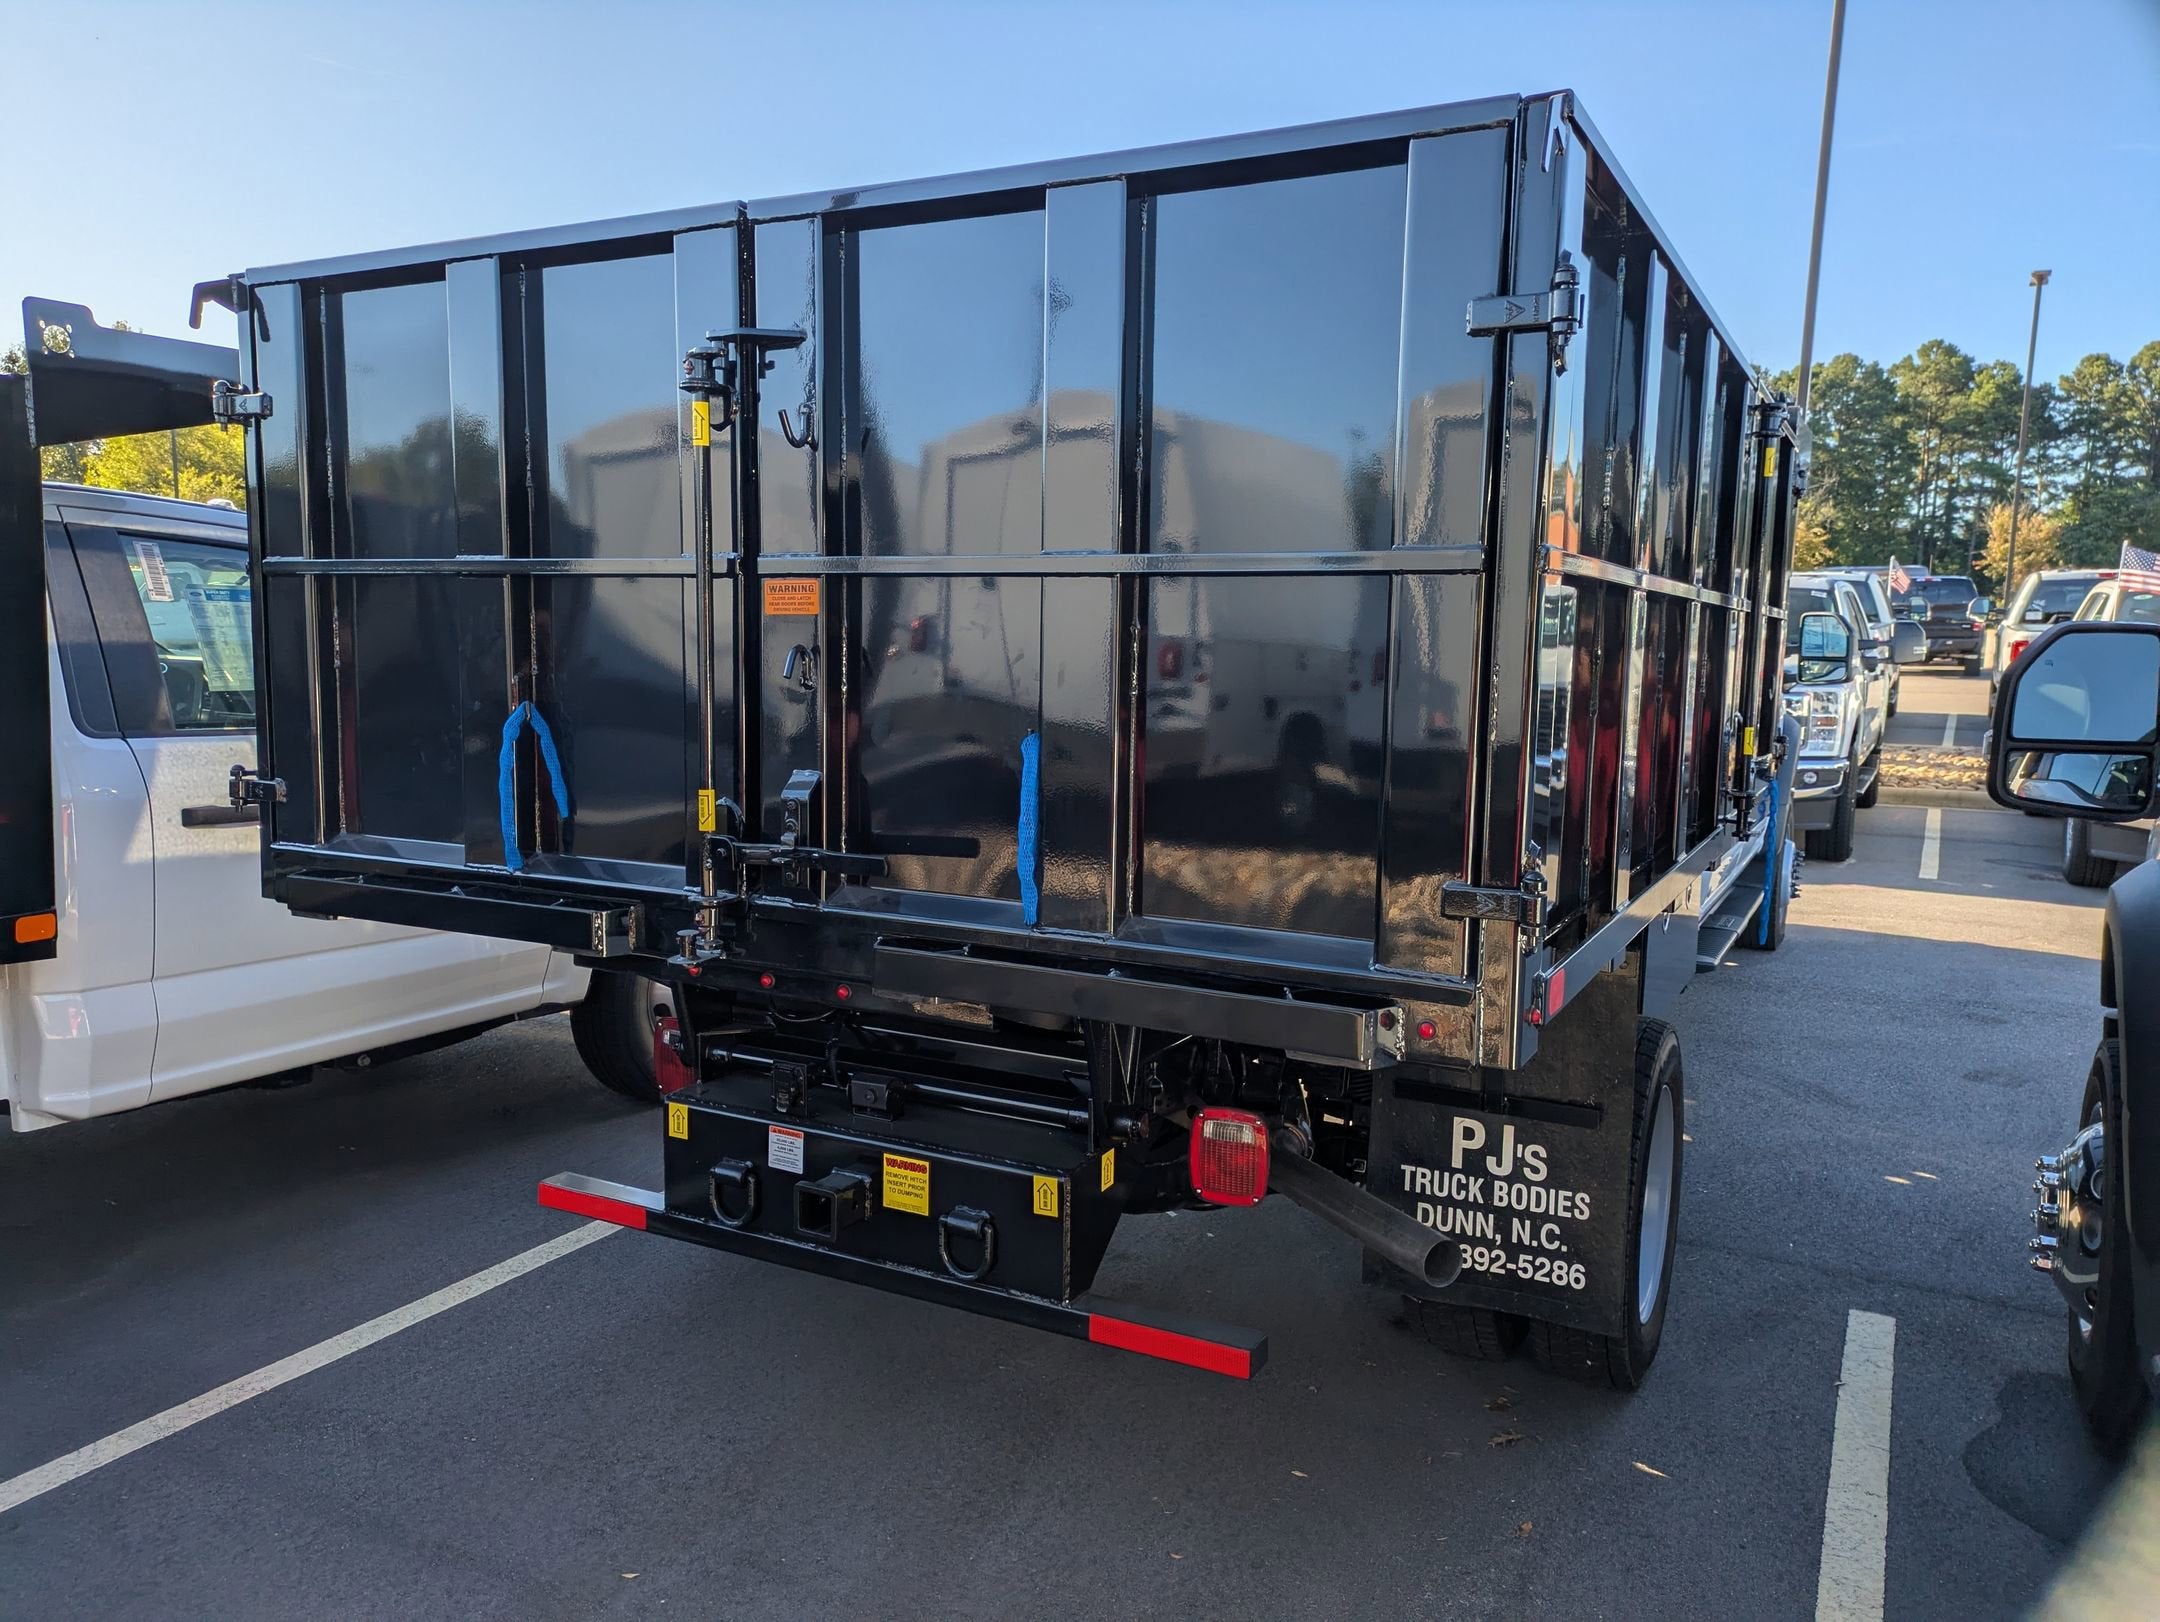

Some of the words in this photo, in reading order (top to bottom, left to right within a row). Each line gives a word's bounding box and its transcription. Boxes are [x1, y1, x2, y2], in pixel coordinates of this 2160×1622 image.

[768, 584, 815, 593] WARNING
[885, 1156, 928, 1174] WARNING
[886, 1171, 909, 1181] REMOVE
[910, 1176, 927, 1185] HITCH
[886, 1179, 907, 1188] INSERT
[908, 1183, 926, 1192] PRIOR
[889, 1186, 897, 1194] TO
[897, 1188, 924, 1199] DUMPING
[1400, 1164, 1485, 1204] TRUCK
[1493, 1180, 1591, 1220] BODIES
[1416, 1202, 1502, 1245] DUNN,
[1511, 1218, 1568, 1252] N.C.
